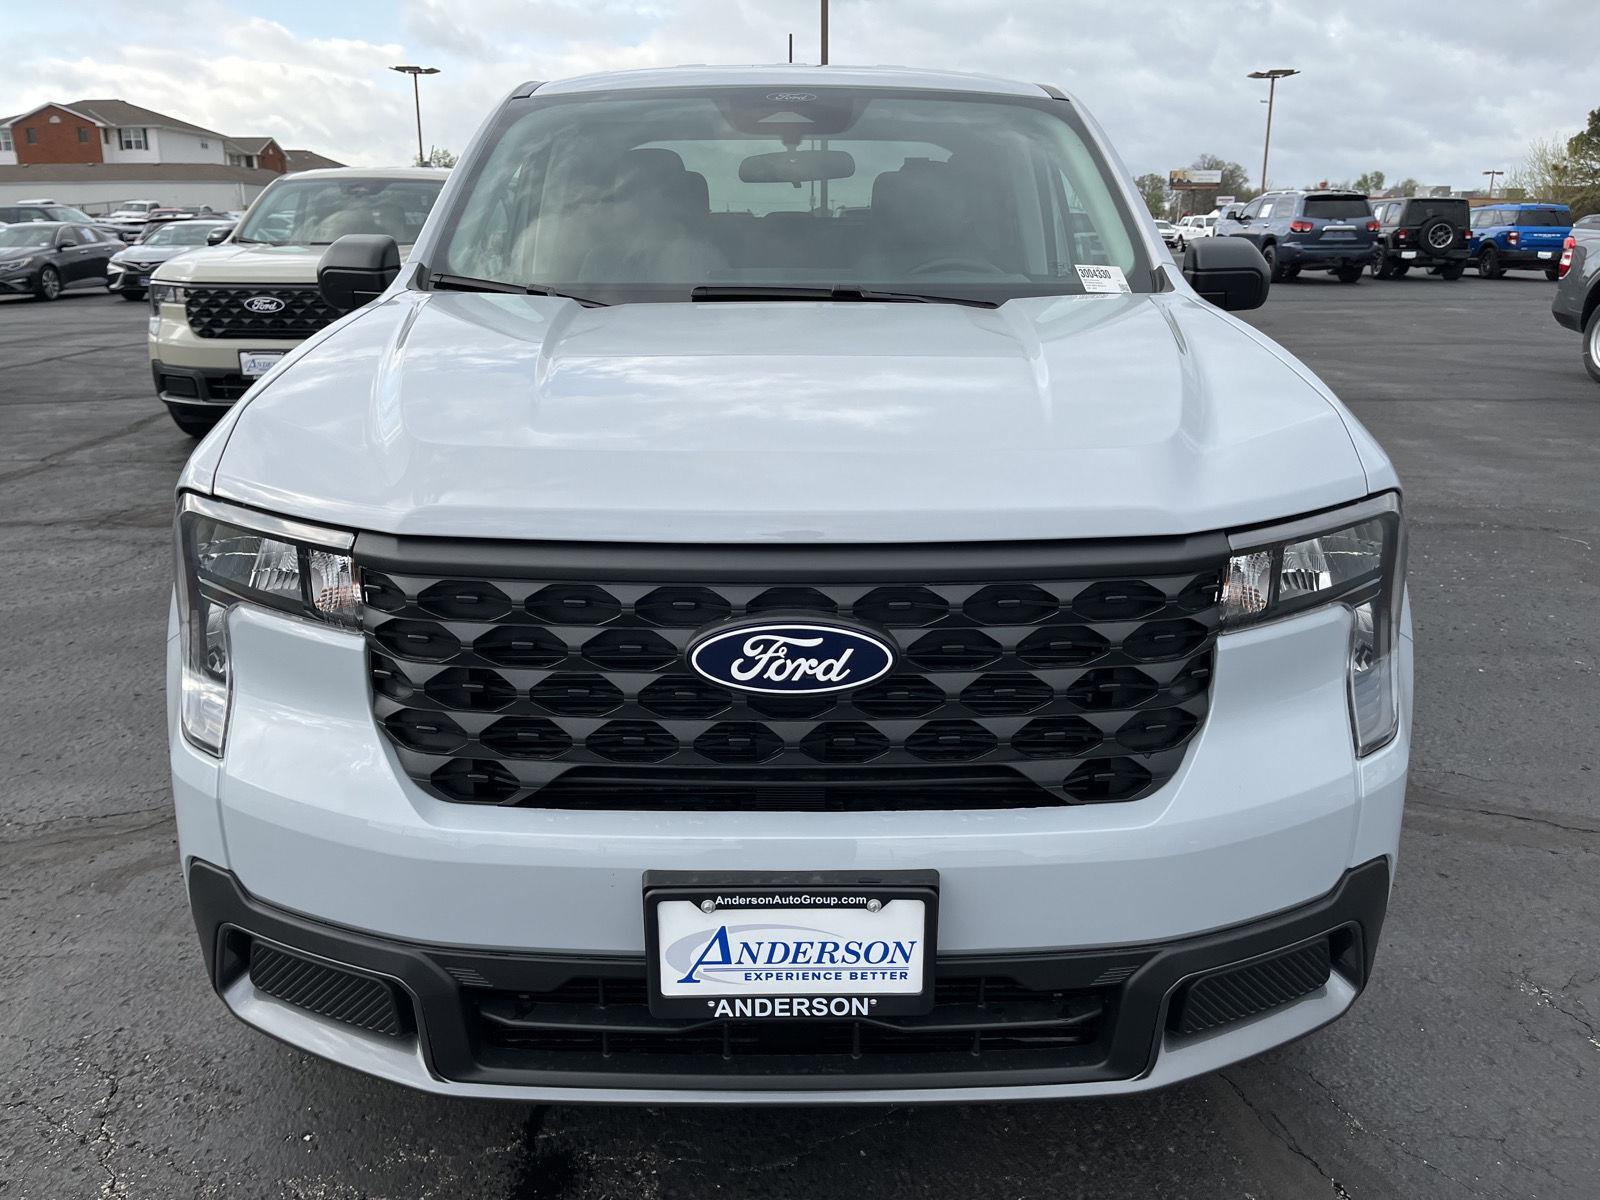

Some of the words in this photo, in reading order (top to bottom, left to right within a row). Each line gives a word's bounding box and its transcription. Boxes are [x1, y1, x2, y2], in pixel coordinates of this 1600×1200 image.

[1078, 268, 1112, 279] 3004330
[251, 299, 278, 311] Ford
[730, 634, 855, 682] Ford
[715, 894, 867, 907] AndersonAutoGroup.com
[676, 925, 918, 984] ANDERSON
[744, 971, 843, 982] EXPERIENCE
[849, 971, 909, 981] BETTER
[713, 997, 870, 1018] ANDERSON
